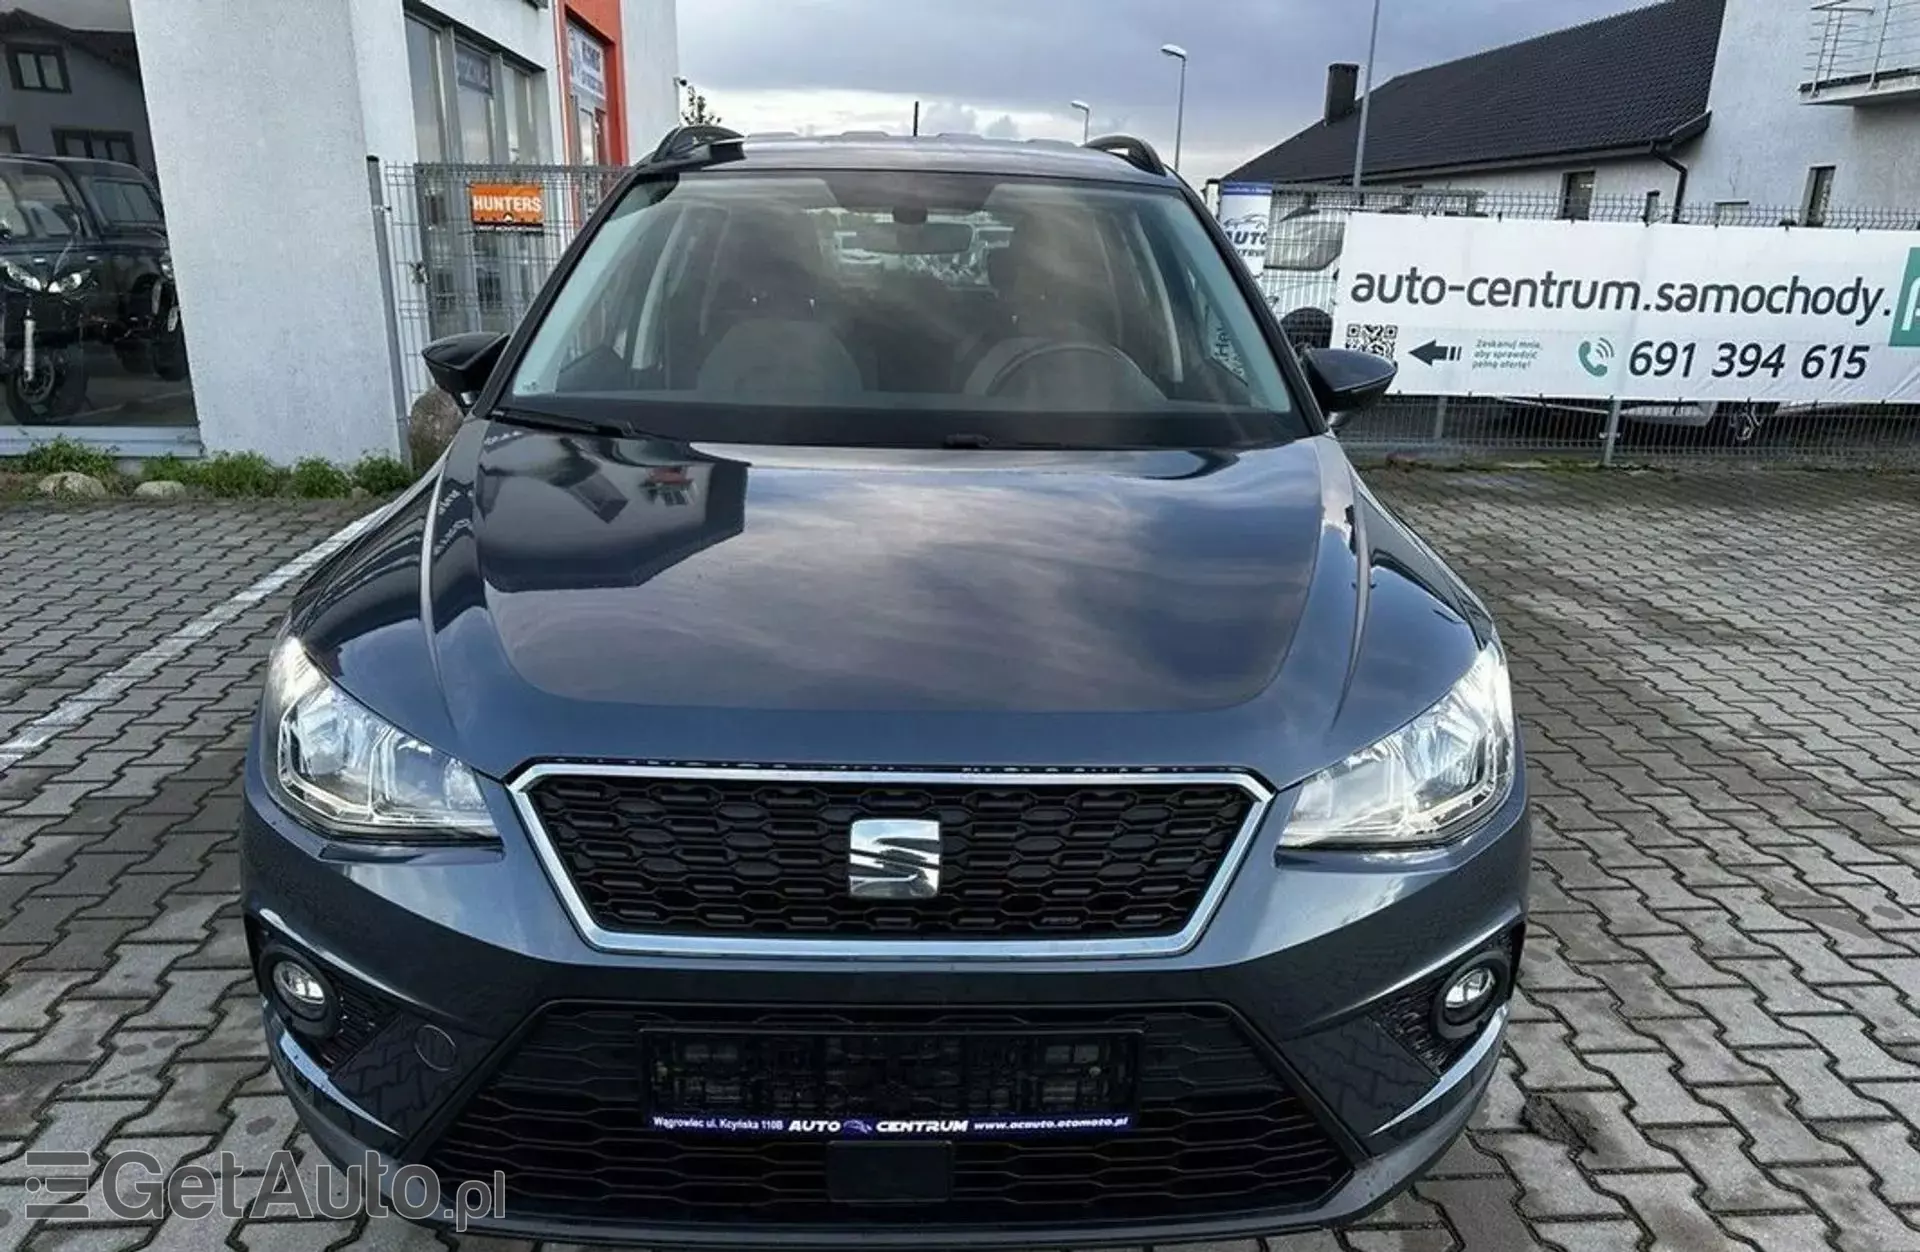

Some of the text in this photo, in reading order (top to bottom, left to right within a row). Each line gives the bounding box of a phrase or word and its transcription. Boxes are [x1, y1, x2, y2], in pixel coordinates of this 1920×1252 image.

[472, 195, 542, 212] HUNTERS
[1628, 340, 1871, 380] 691 394 615
[787, 1119, 841, 1132] AUTO
[875, 1119, 969, 1133] CENTRUM
